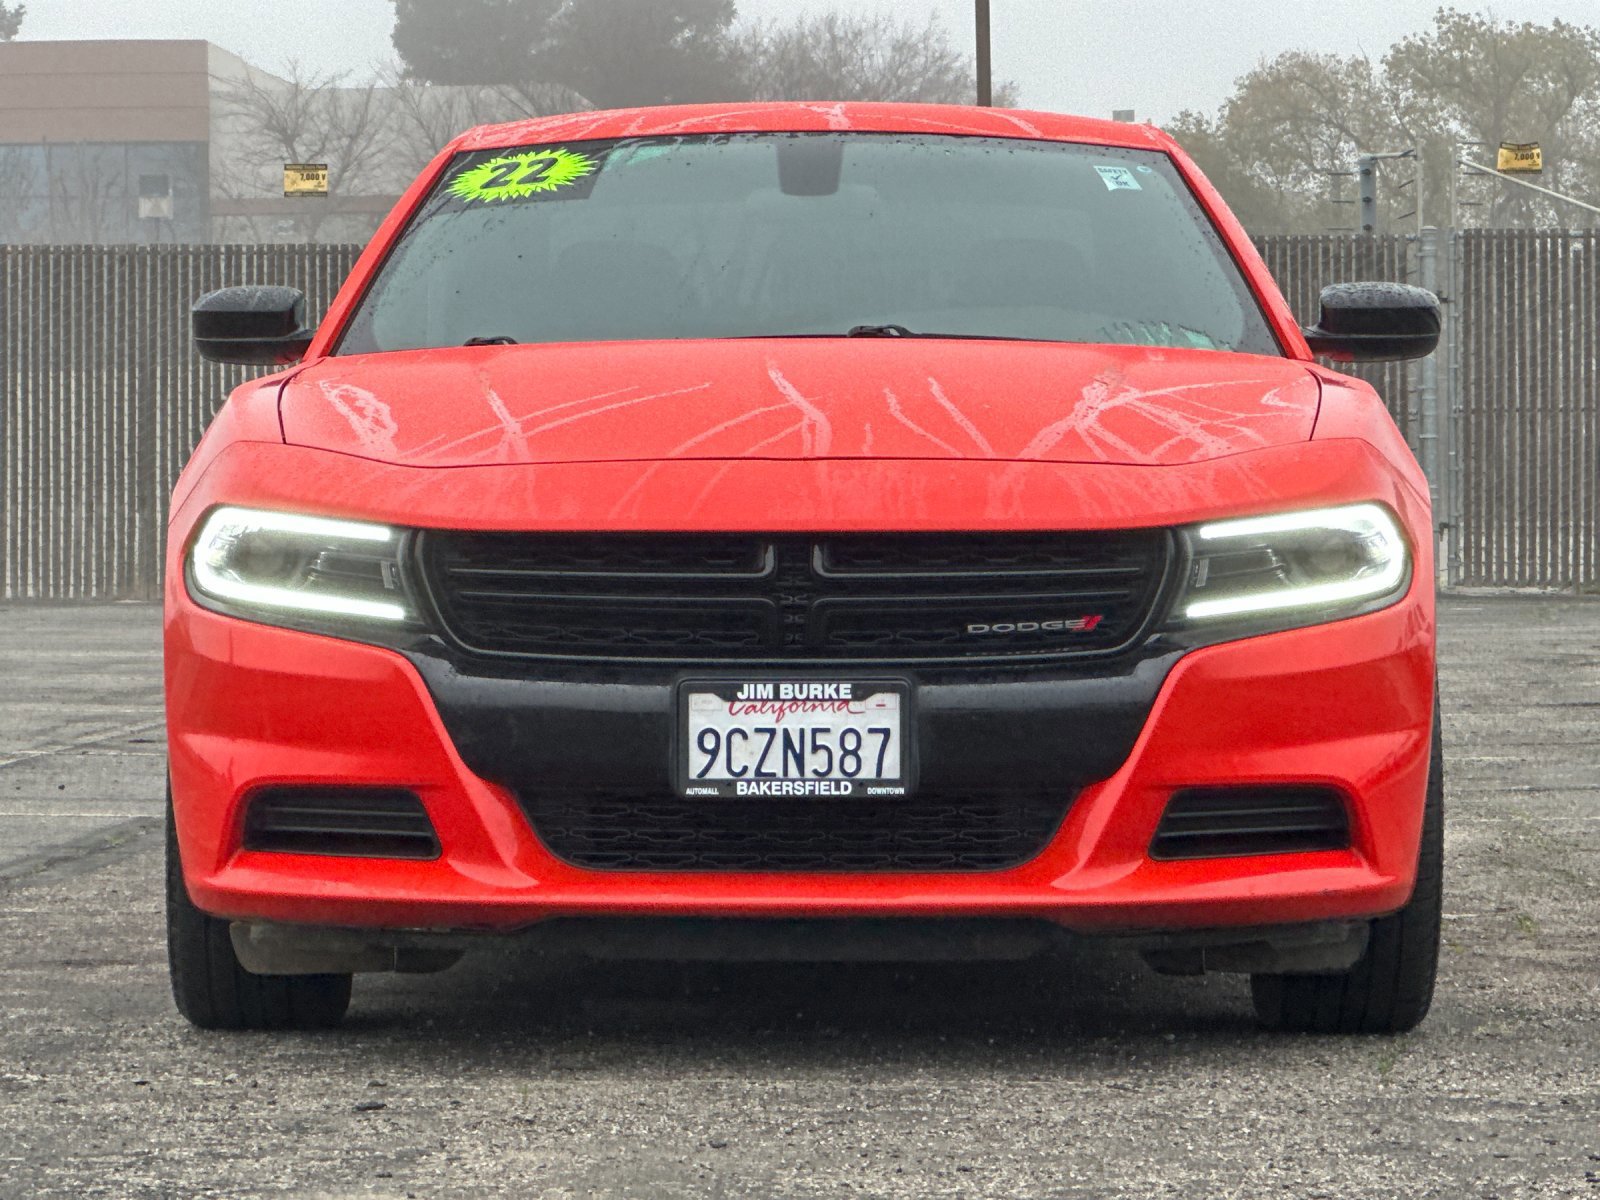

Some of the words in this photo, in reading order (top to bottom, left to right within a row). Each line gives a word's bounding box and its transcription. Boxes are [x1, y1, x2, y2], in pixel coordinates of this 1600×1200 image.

[300, 173, 320, 181] 7,000
[479, 157, 559, 190] 22
[967, 619, 1086, 633] DODGE
[737, 683, 774, 700] JIM
[780, 683, 852, 700] BURKE
[696, 727, 891, 779] 9CZN587
[686, 787, 719, 795] AUTOMALL
[736, 781, 852, 796] BAKERSFIELD
[867, 787, 905, 795] DOWNTOWN
